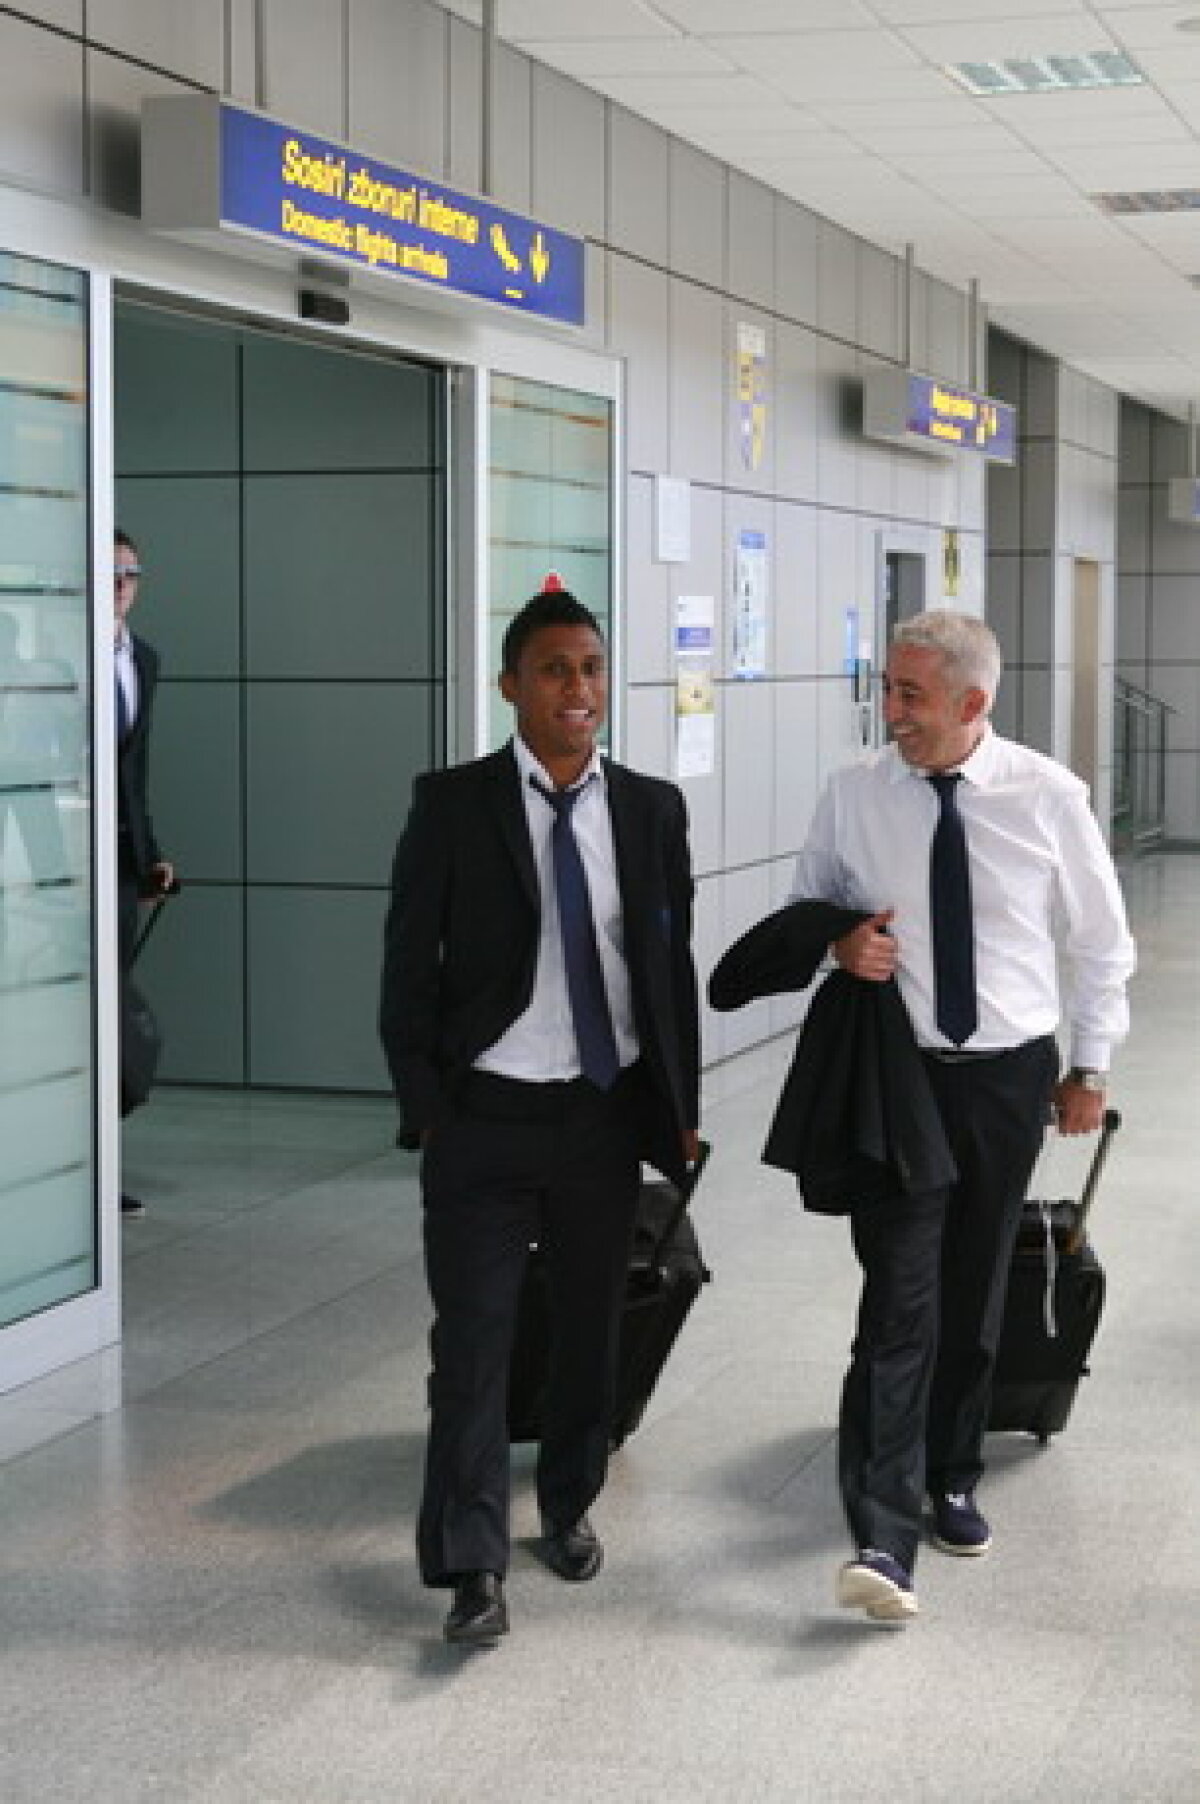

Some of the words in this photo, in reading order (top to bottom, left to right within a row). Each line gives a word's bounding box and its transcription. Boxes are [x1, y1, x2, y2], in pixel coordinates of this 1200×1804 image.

[282, 140, 345, 200] Sosiri
[348, 168, 417, 223] zboruri
[418, 188, 479, 244] interne
[282, 199, 352, 250] Domestic
